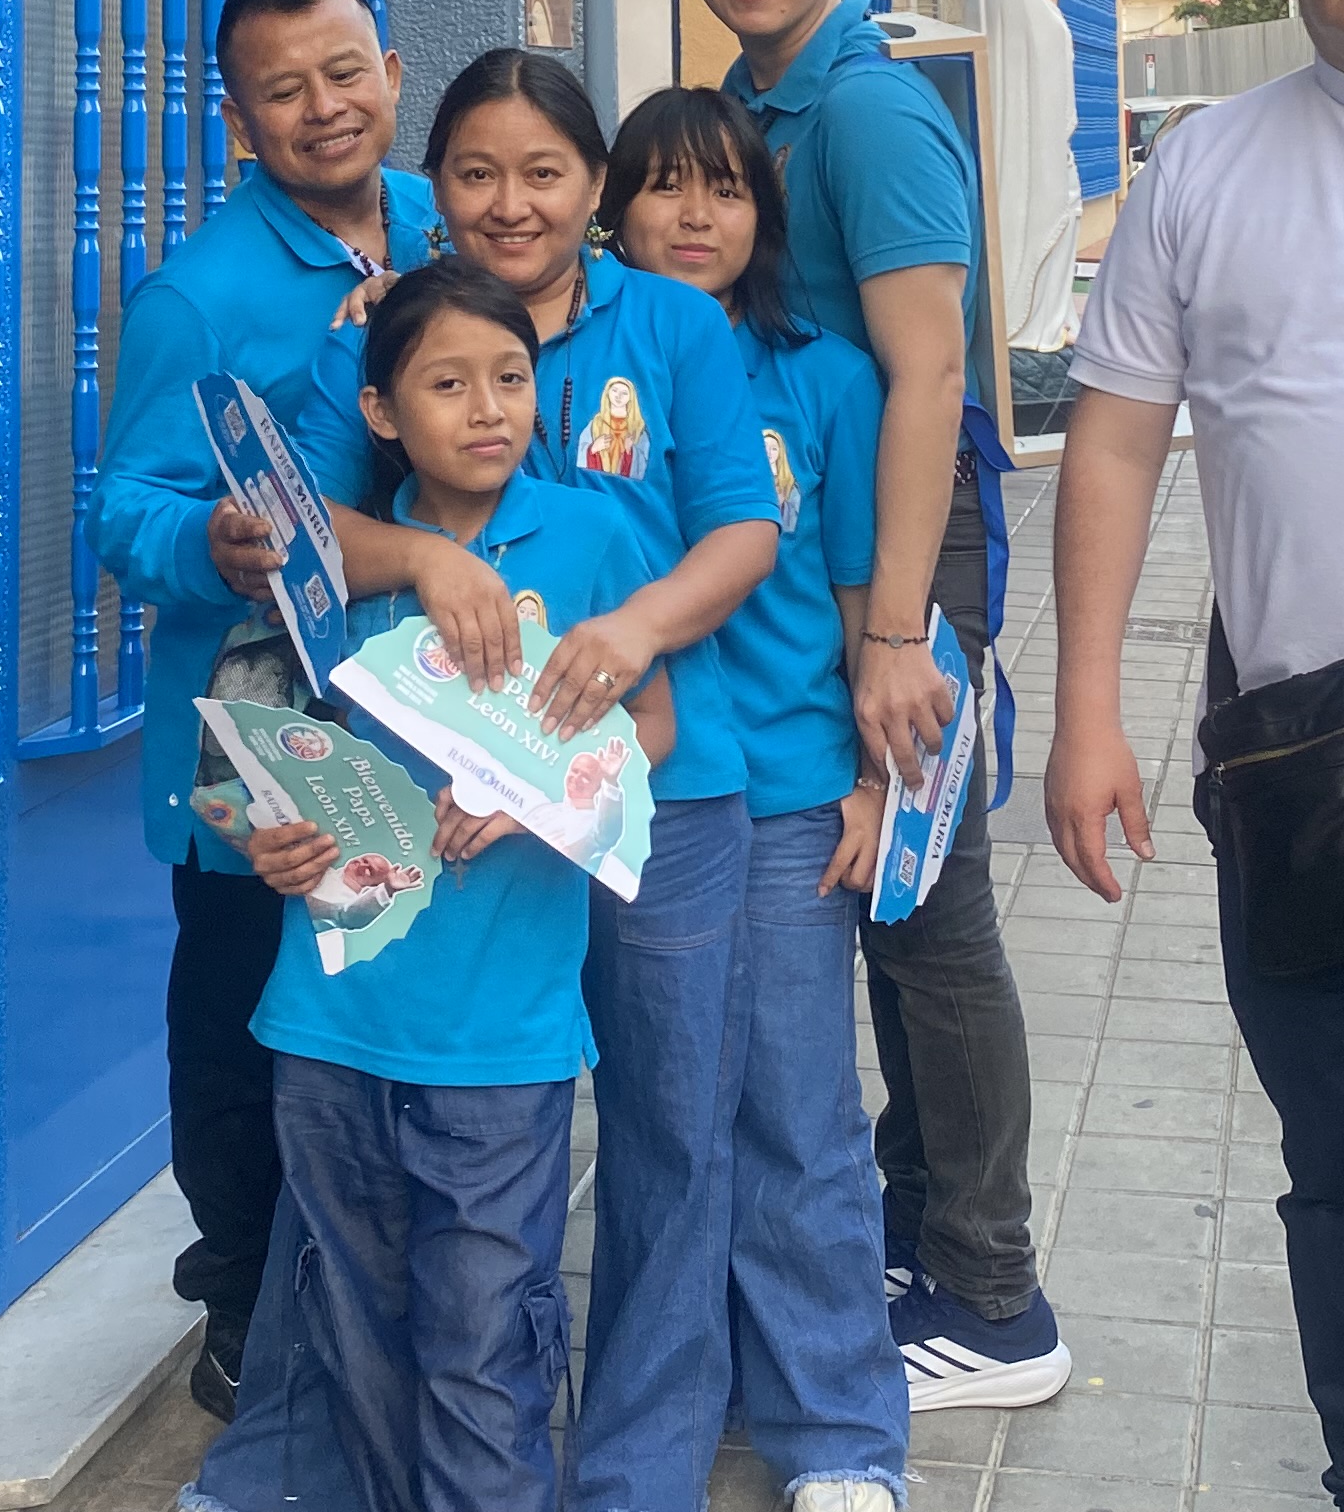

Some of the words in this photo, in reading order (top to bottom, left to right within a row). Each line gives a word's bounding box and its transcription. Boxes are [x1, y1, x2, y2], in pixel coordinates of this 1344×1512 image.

[260, 418, 296, 480] RADIO
[295, 484, 329, 548] MARIA
[467, 692, 518, 738] León
[518, 730, 560, 766] XIV!
[447, 747, 486, 779] RADIO
[487, 776, 525, 809] MARIA
[949, 733, 971, 794] RADIO
[305, 775, 338, 816] León
[331, 816, 361, 847] XIV!
[342, 786, 376, 828] Papa
[343, 756, 414, 856] ¡Bienvenido,
[932, 800, 953, 860] MARIA
